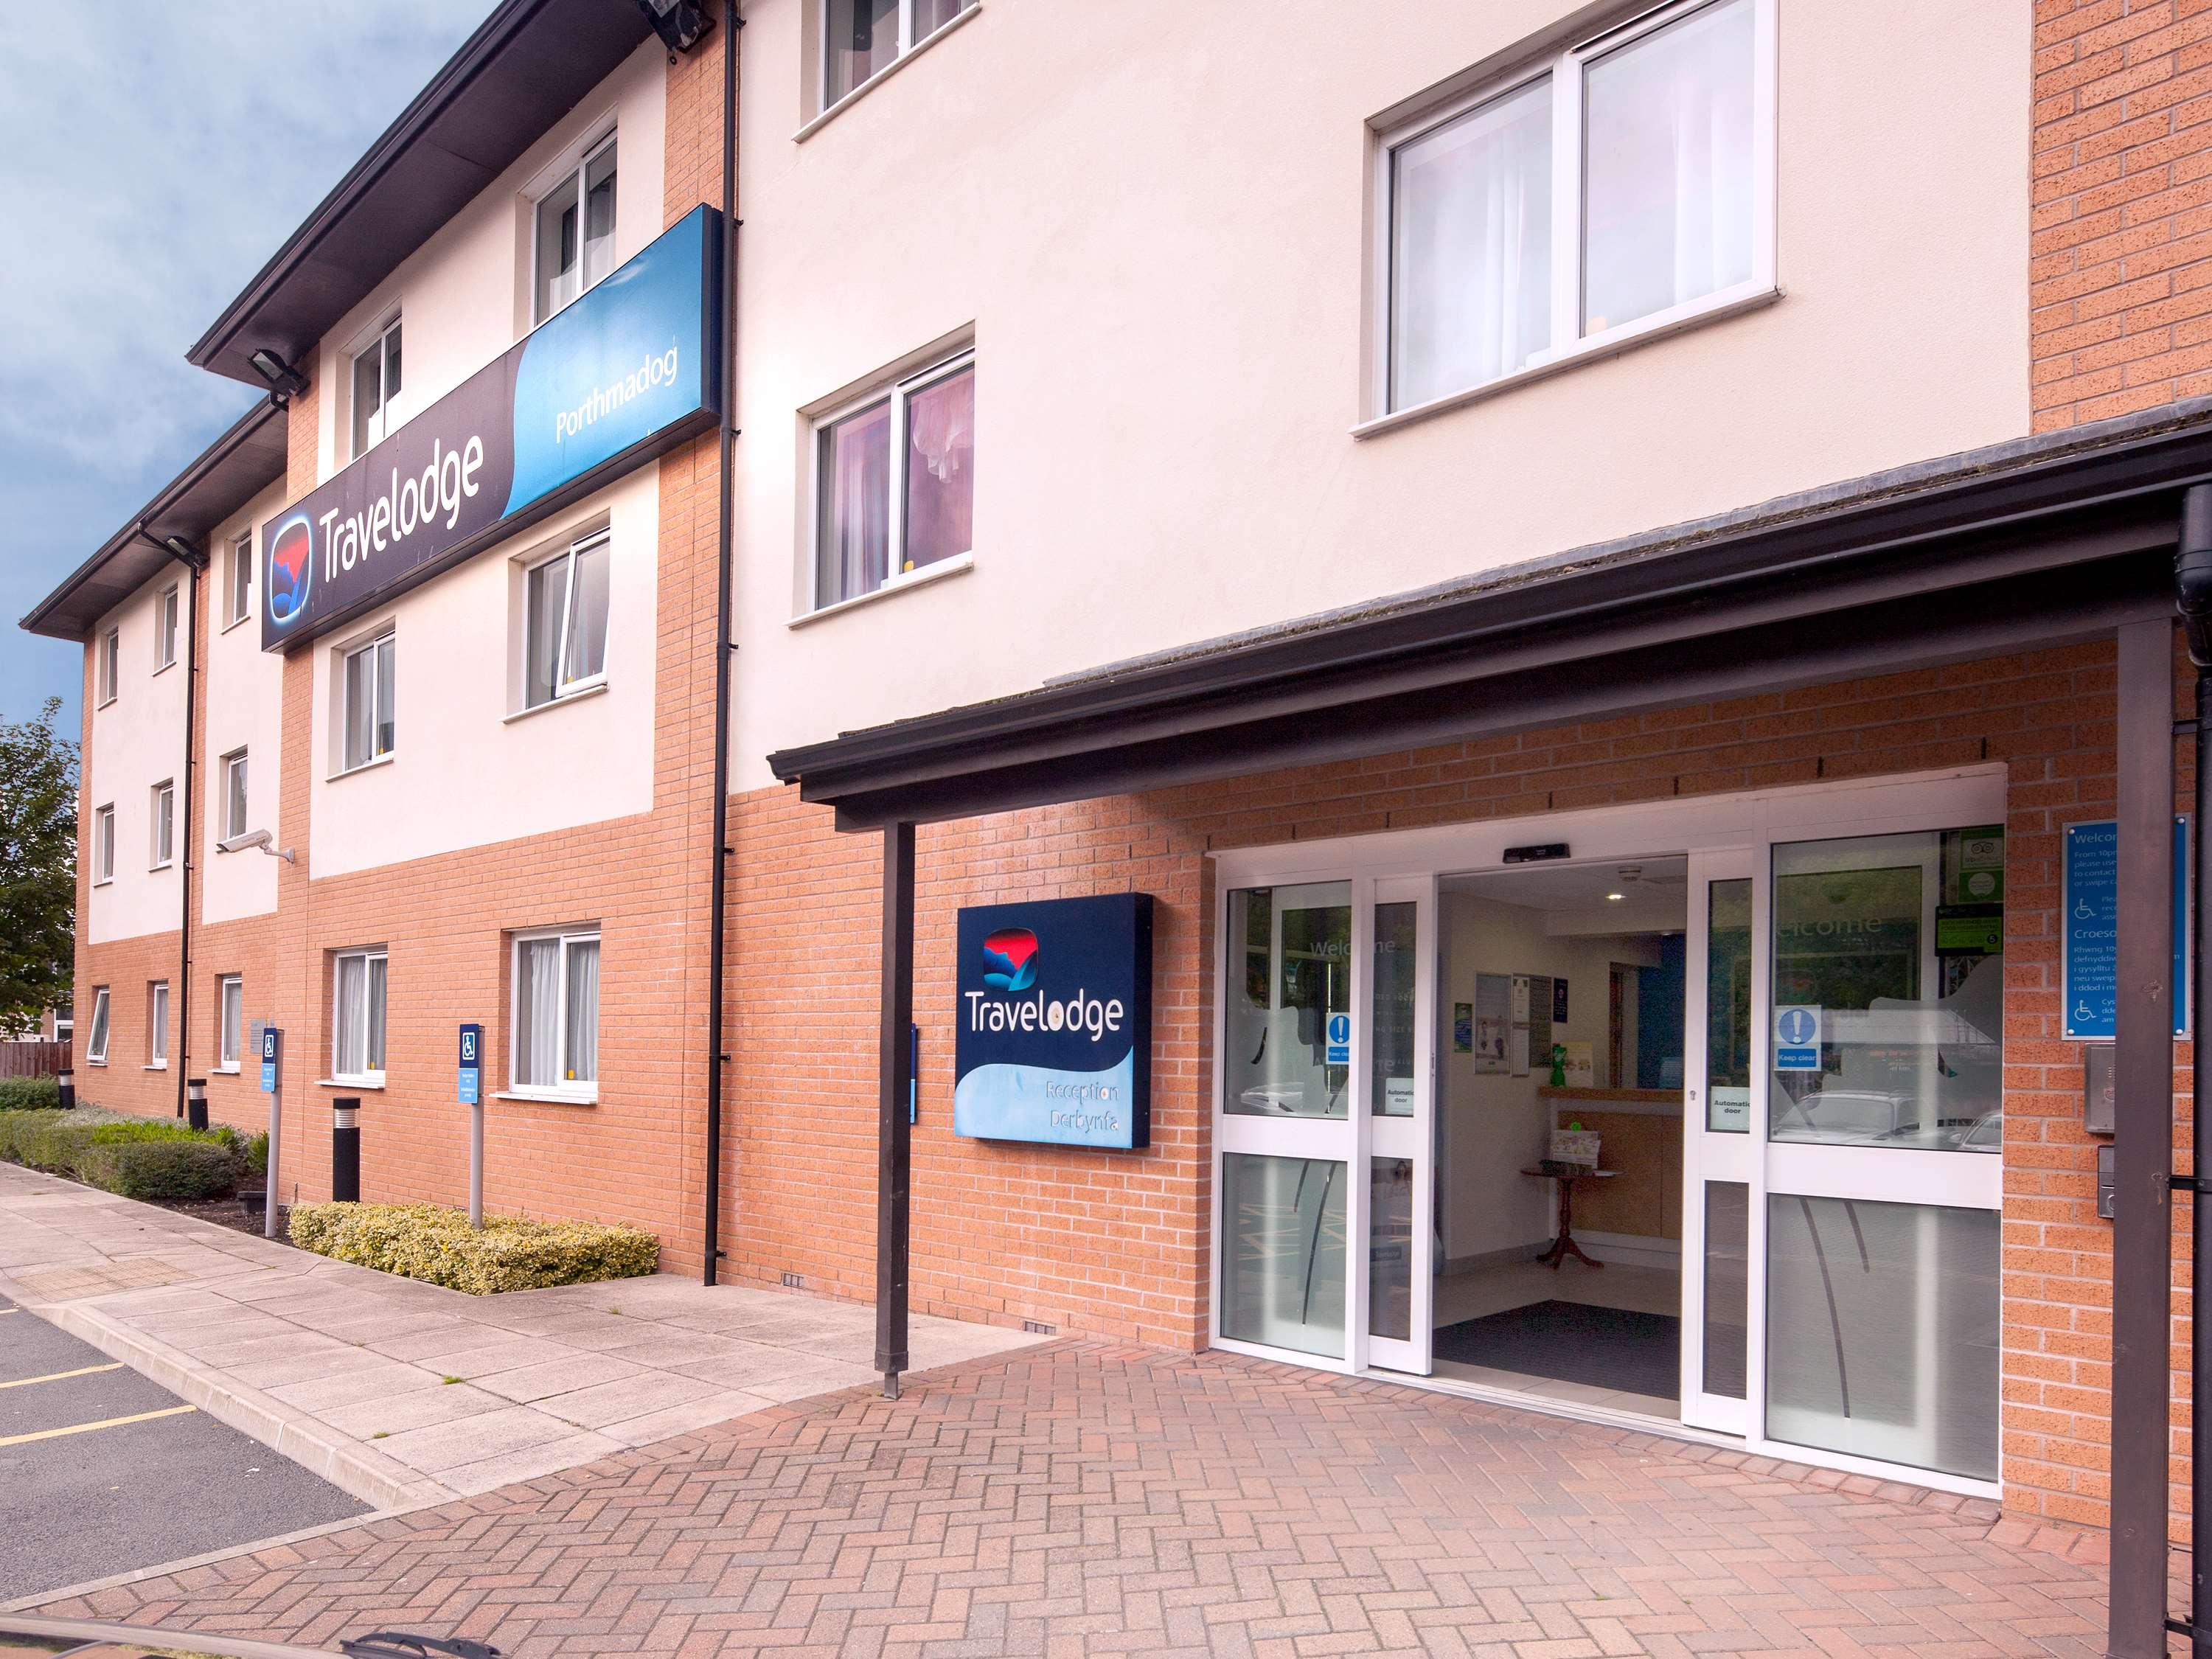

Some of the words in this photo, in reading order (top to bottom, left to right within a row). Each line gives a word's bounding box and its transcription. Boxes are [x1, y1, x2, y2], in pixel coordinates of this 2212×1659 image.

[556, 344, 678, 443] Porthmadog
[319, 435, 484, 582] Travelodge
[2075, 832, 2116, 844] Welco
[964, 988, 1124, 1042] Travelodge
[1778, 1054, 1797, 1062] Keep
[1046, 1081, 1119, 1104] Reception
[1050, 1109, 1119, 1134] Derbynfa
